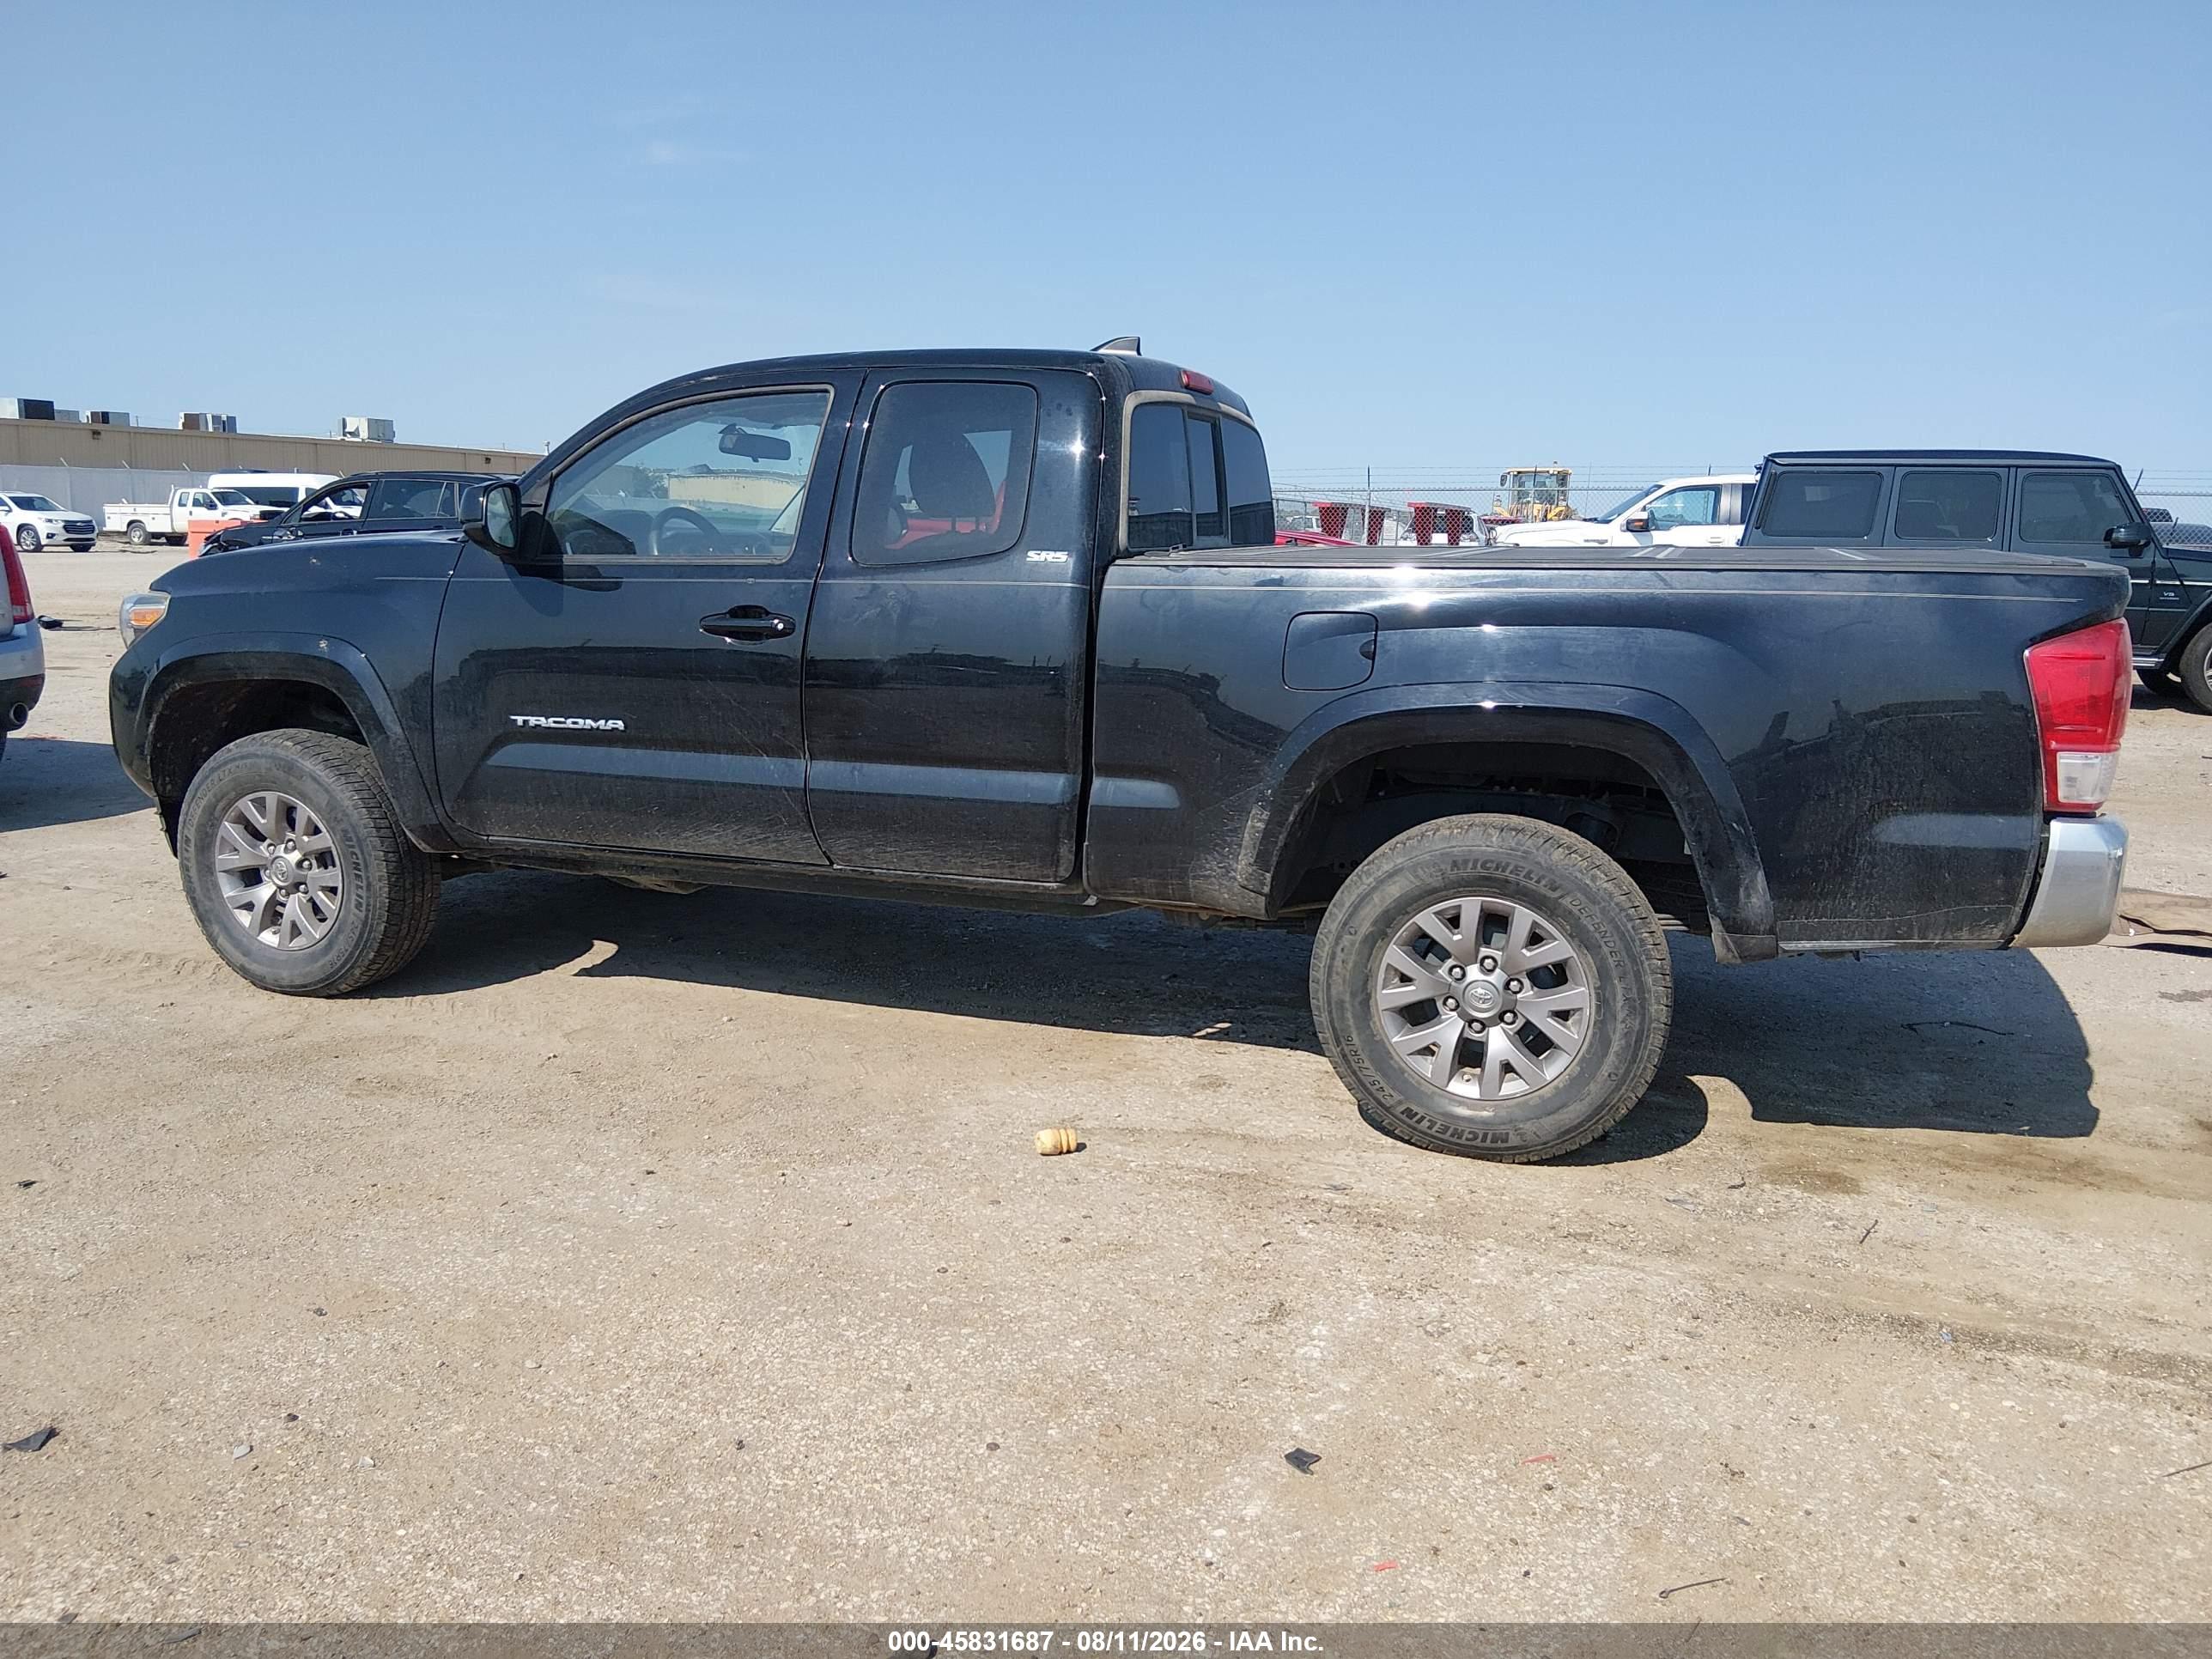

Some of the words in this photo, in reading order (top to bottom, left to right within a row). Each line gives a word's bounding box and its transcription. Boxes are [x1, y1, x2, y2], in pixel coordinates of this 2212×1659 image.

[1026, 550, 1069, 562] SR5
[509, 715, 625, 730] TACOMA
[340, 827, 365, 914] MICHELIN
[1449, 857, 1560, 892] MICHELIN
[1569, 897, 1626, 969] DEFENDER
[1618, 974, 1633, 1006] LTX
[1345, 1035, 1395, 1101] 245/75R16
[1399, 1106, 1510, 1144] MICHELIN
